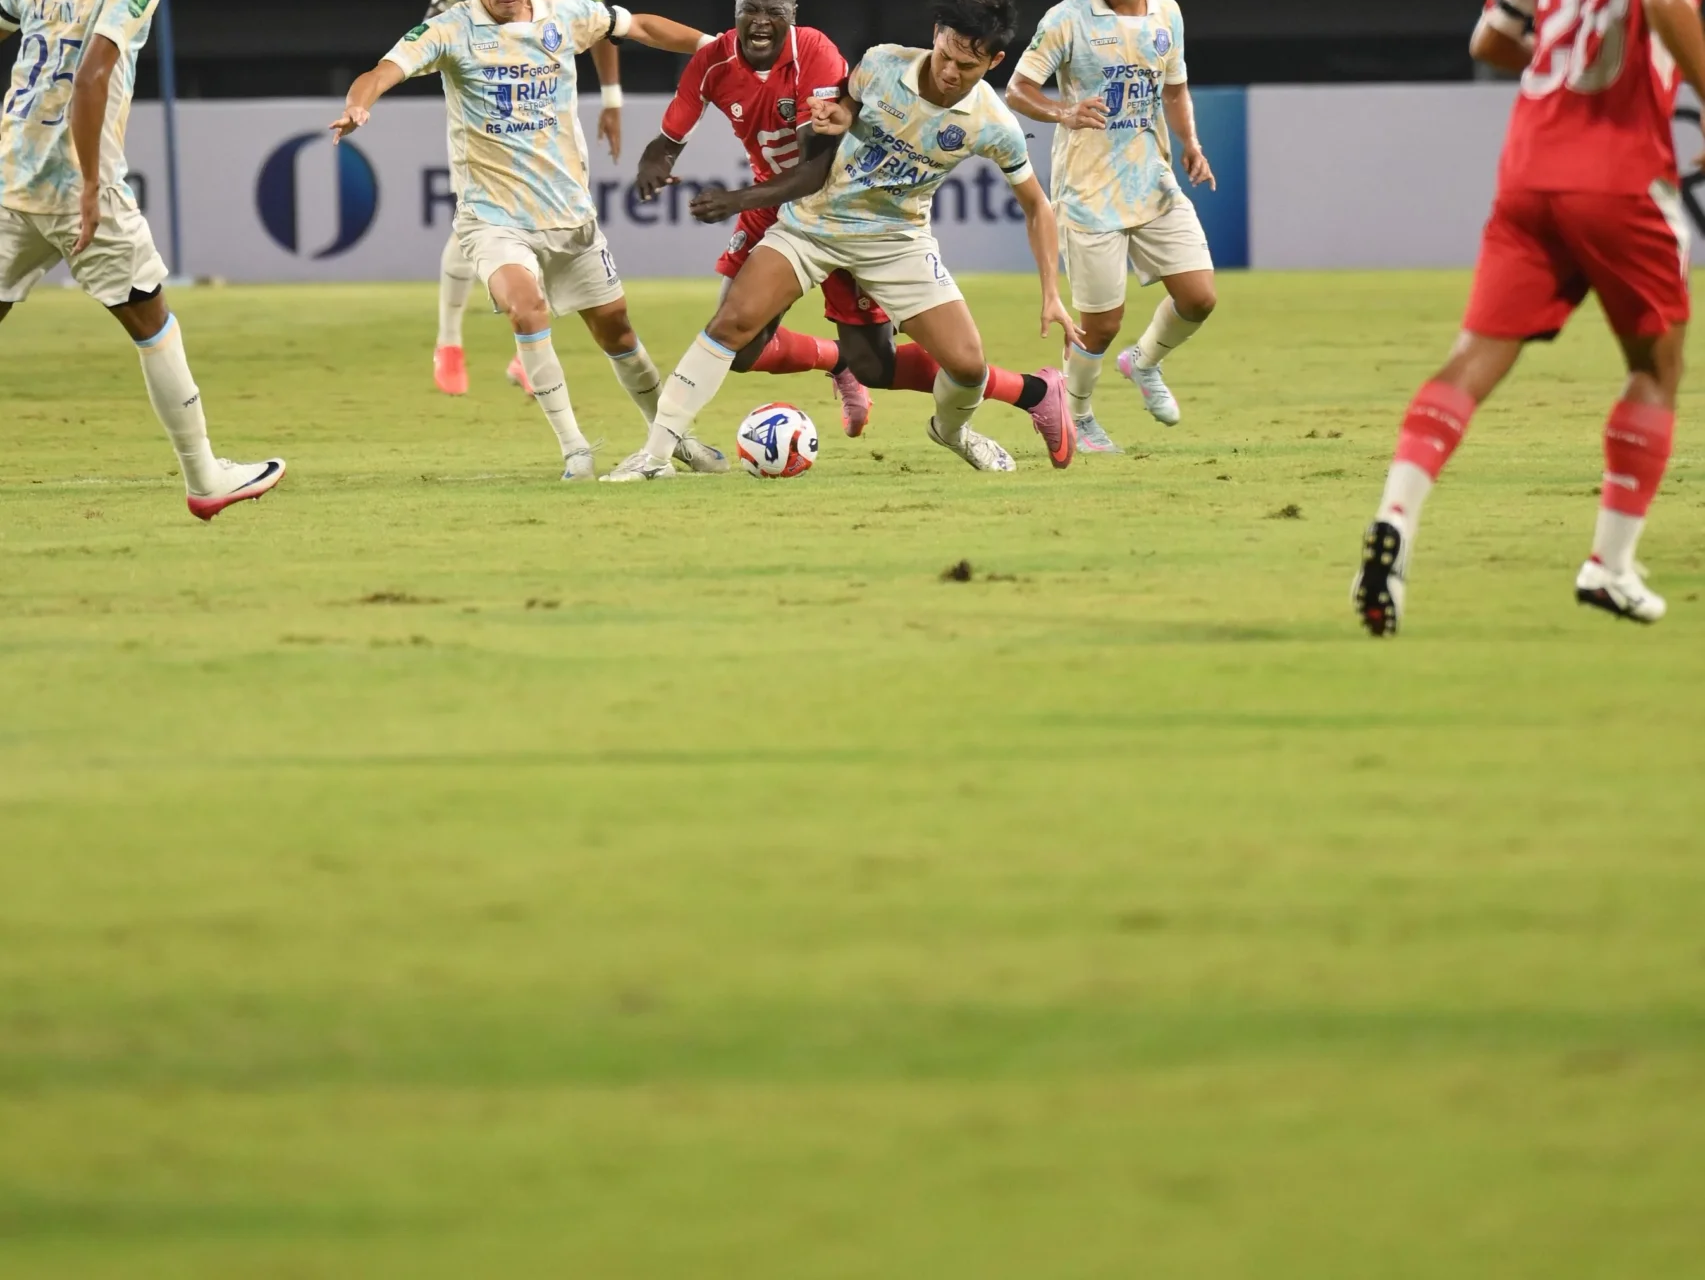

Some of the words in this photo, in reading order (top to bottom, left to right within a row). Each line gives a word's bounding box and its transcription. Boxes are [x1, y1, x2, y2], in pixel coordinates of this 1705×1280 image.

[517, 77, 557, 101] RIAU
[486, 124, 501, 134] RS
[506, 122, 536, 133] AWAL
[1109, 118, 1138, 130] AWAL
